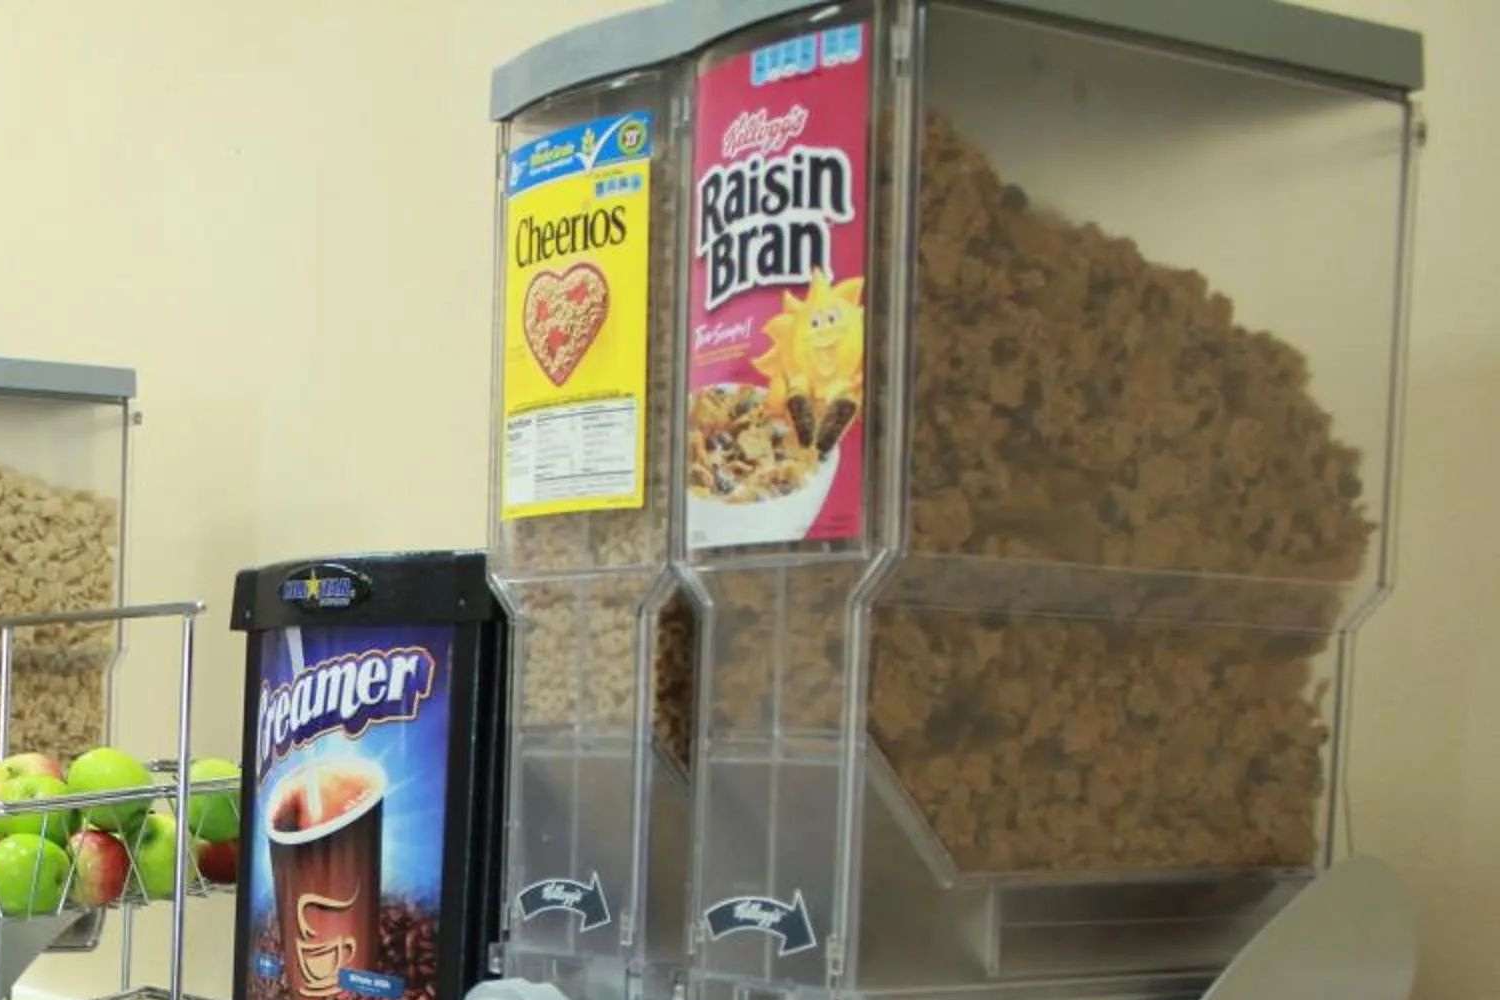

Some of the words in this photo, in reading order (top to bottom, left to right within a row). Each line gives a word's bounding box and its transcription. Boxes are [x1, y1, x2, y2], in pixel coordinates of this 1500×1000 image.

[722, 104, 808, 158] Kellogg's
[700, 151, 849, 244] Raisin
[516, 204, 628, 268] Cheerios
[710, 221, 824, 300] Bran
